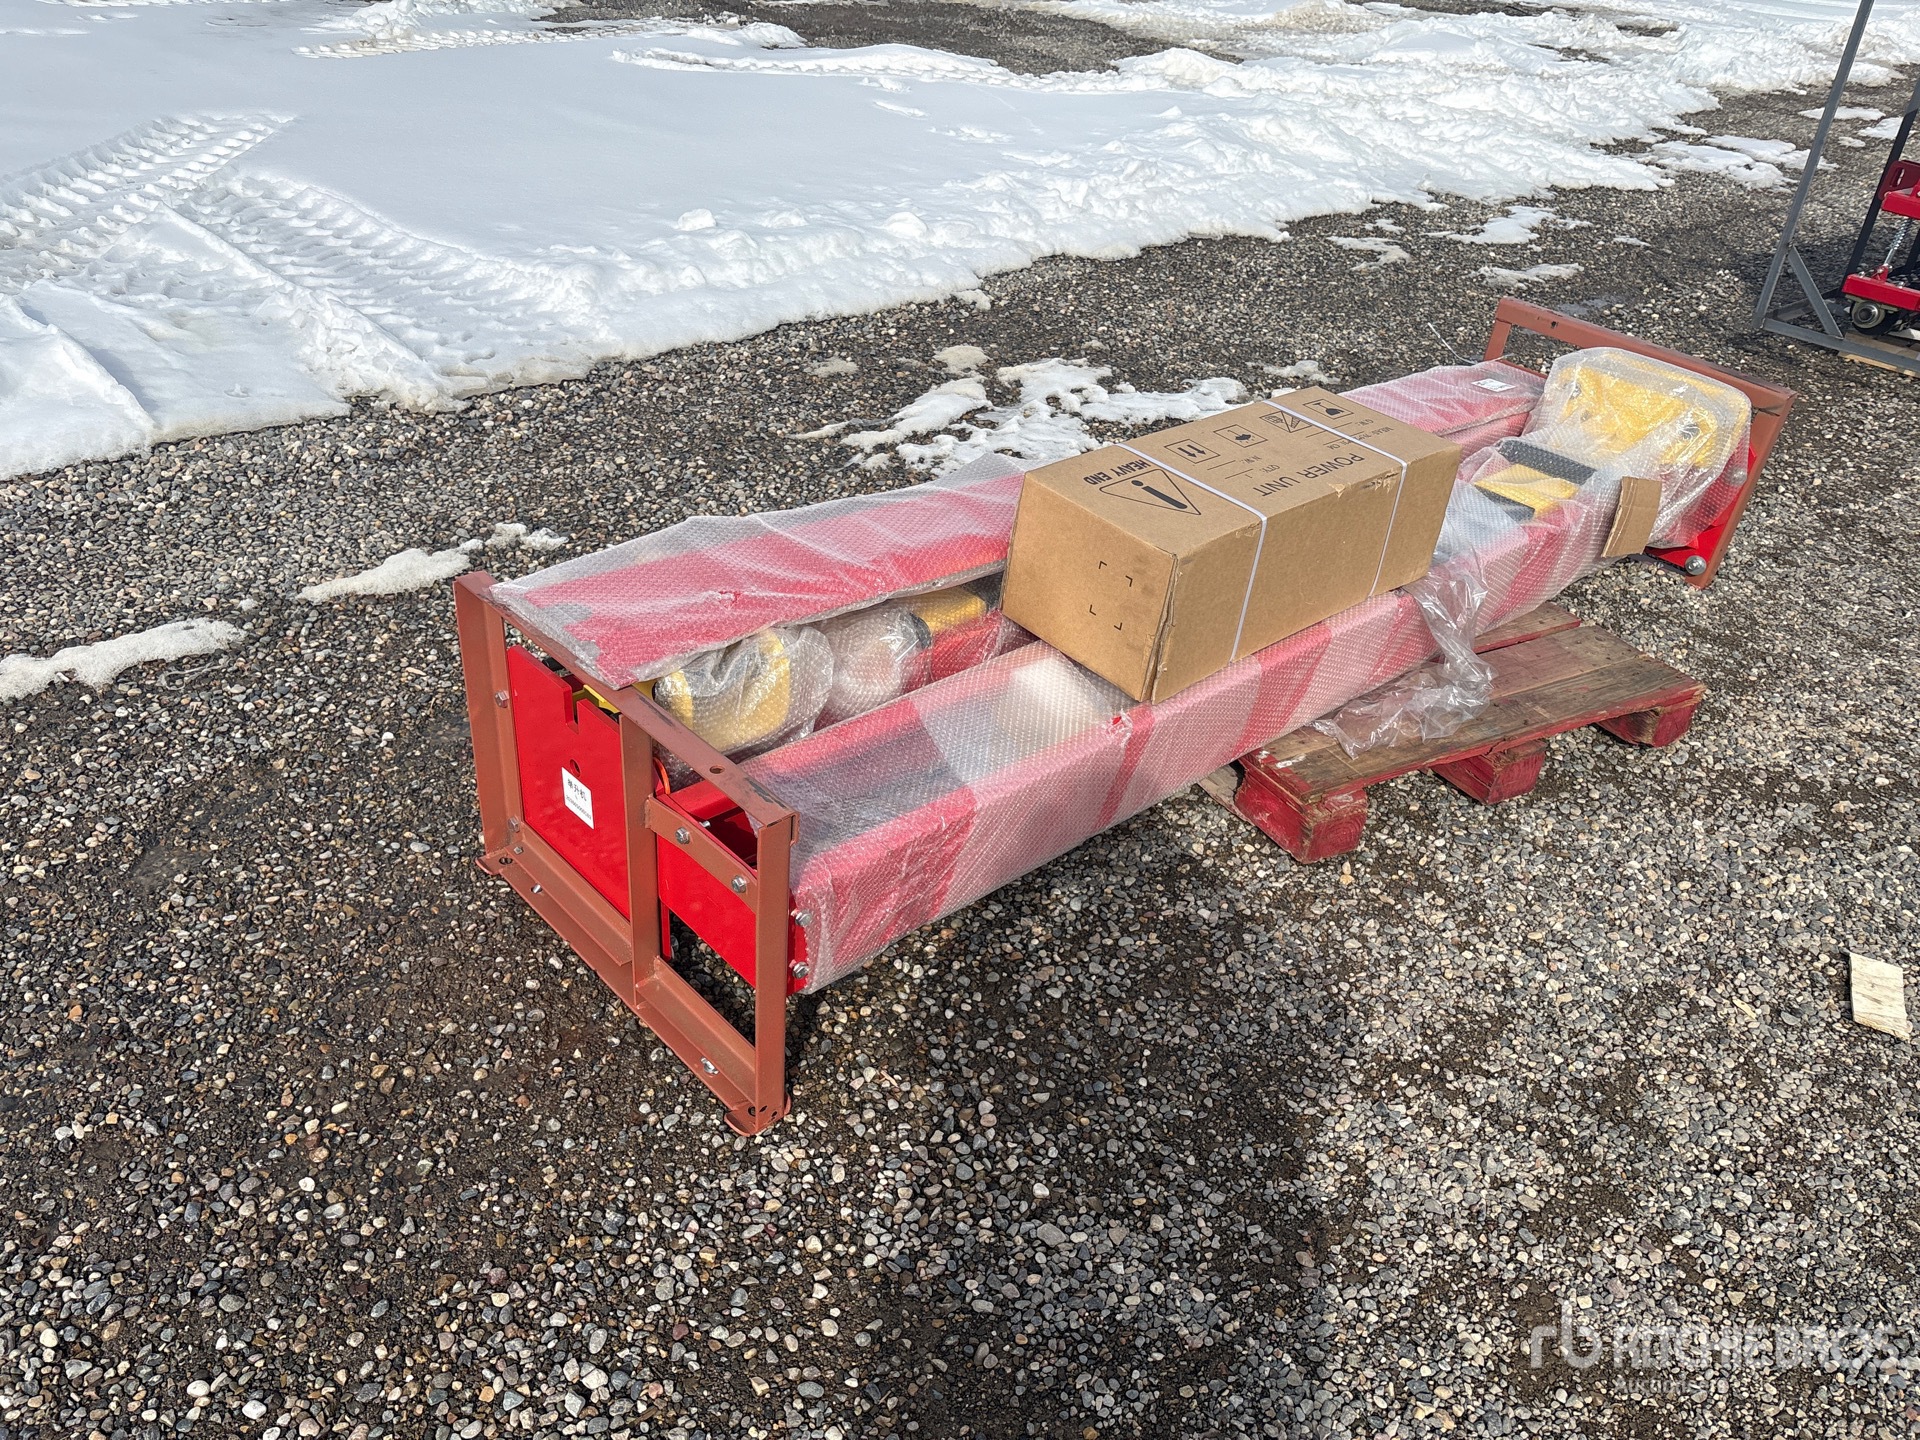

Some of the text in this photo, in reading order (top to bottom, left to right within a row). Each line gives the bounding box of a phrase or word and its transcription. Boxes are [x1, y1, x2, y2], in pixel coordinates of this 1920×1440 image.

[1083, 458, 1151, 485] HEAVY END
[1252, 452, 1365, 497] POWER UNIT
